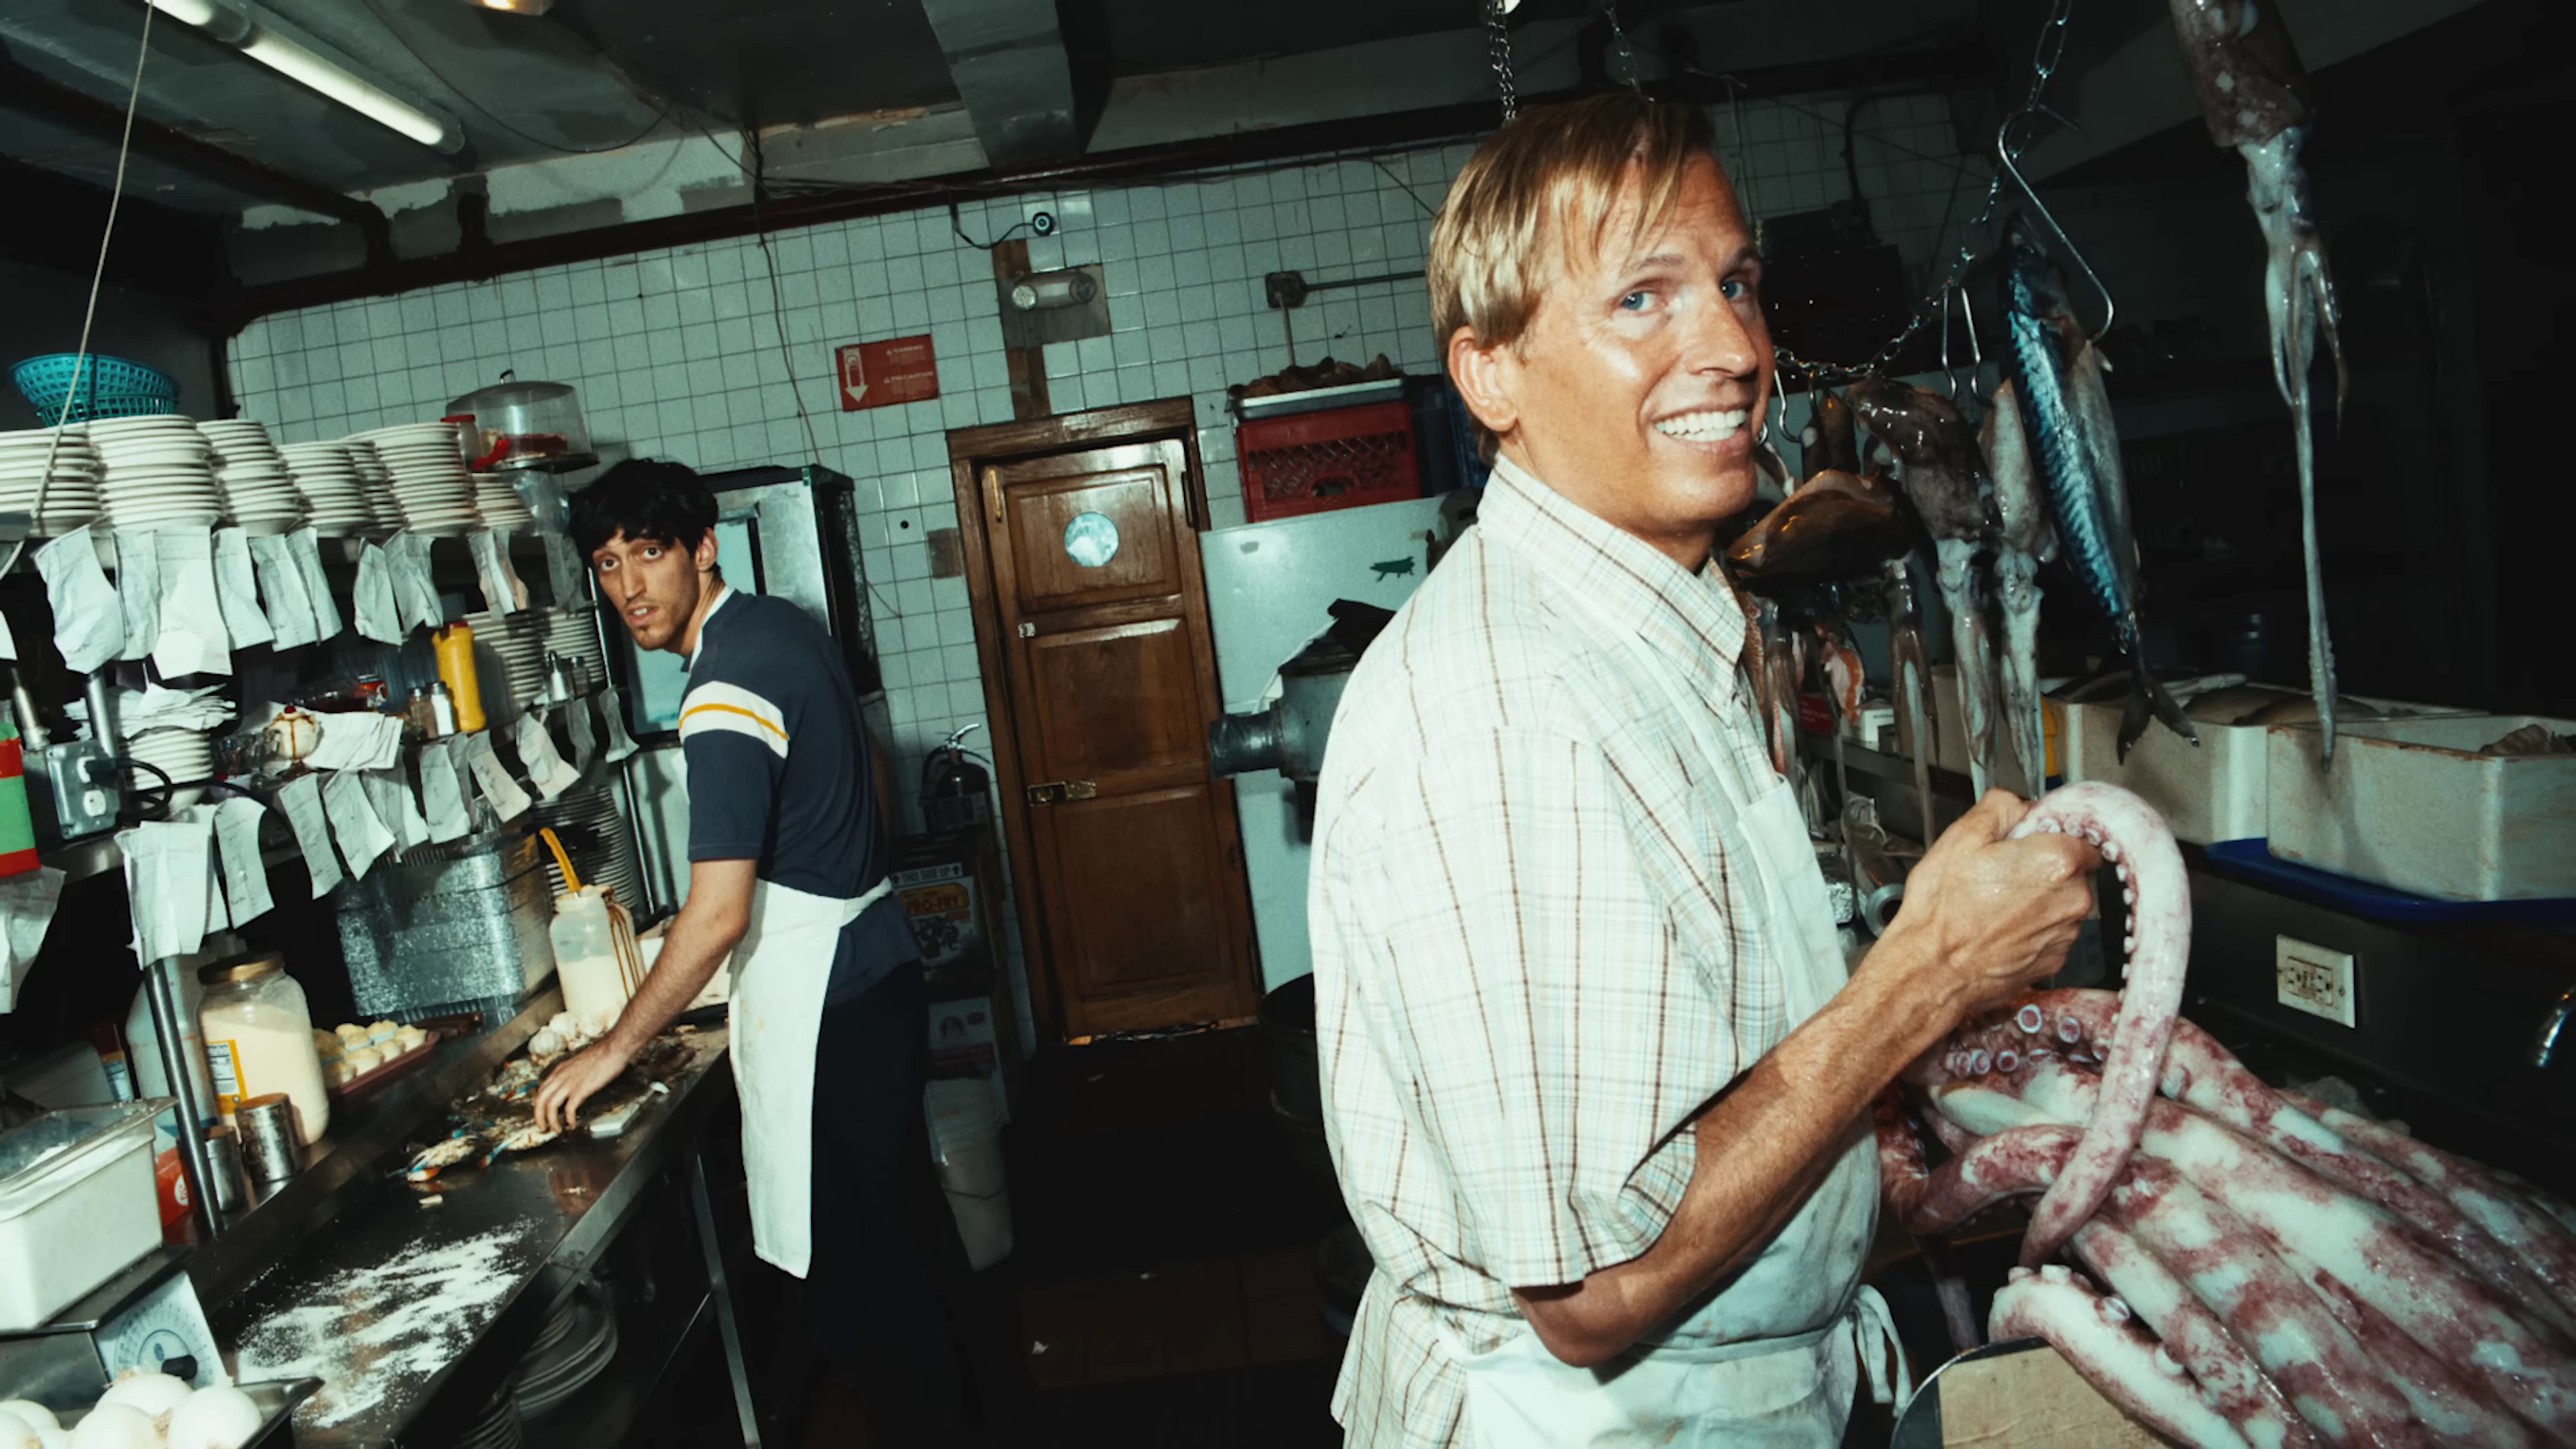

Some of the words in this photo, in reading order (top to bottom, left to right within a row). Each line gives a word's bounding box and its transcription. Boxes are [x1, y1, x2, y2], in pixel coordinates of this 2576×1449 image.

[902, 871, 918, 881] THIS
[920, 869, 936, 879] SIDE
[940, 866, 950, 876] UP
[906, 895, 959, 913] PRO-FRY
